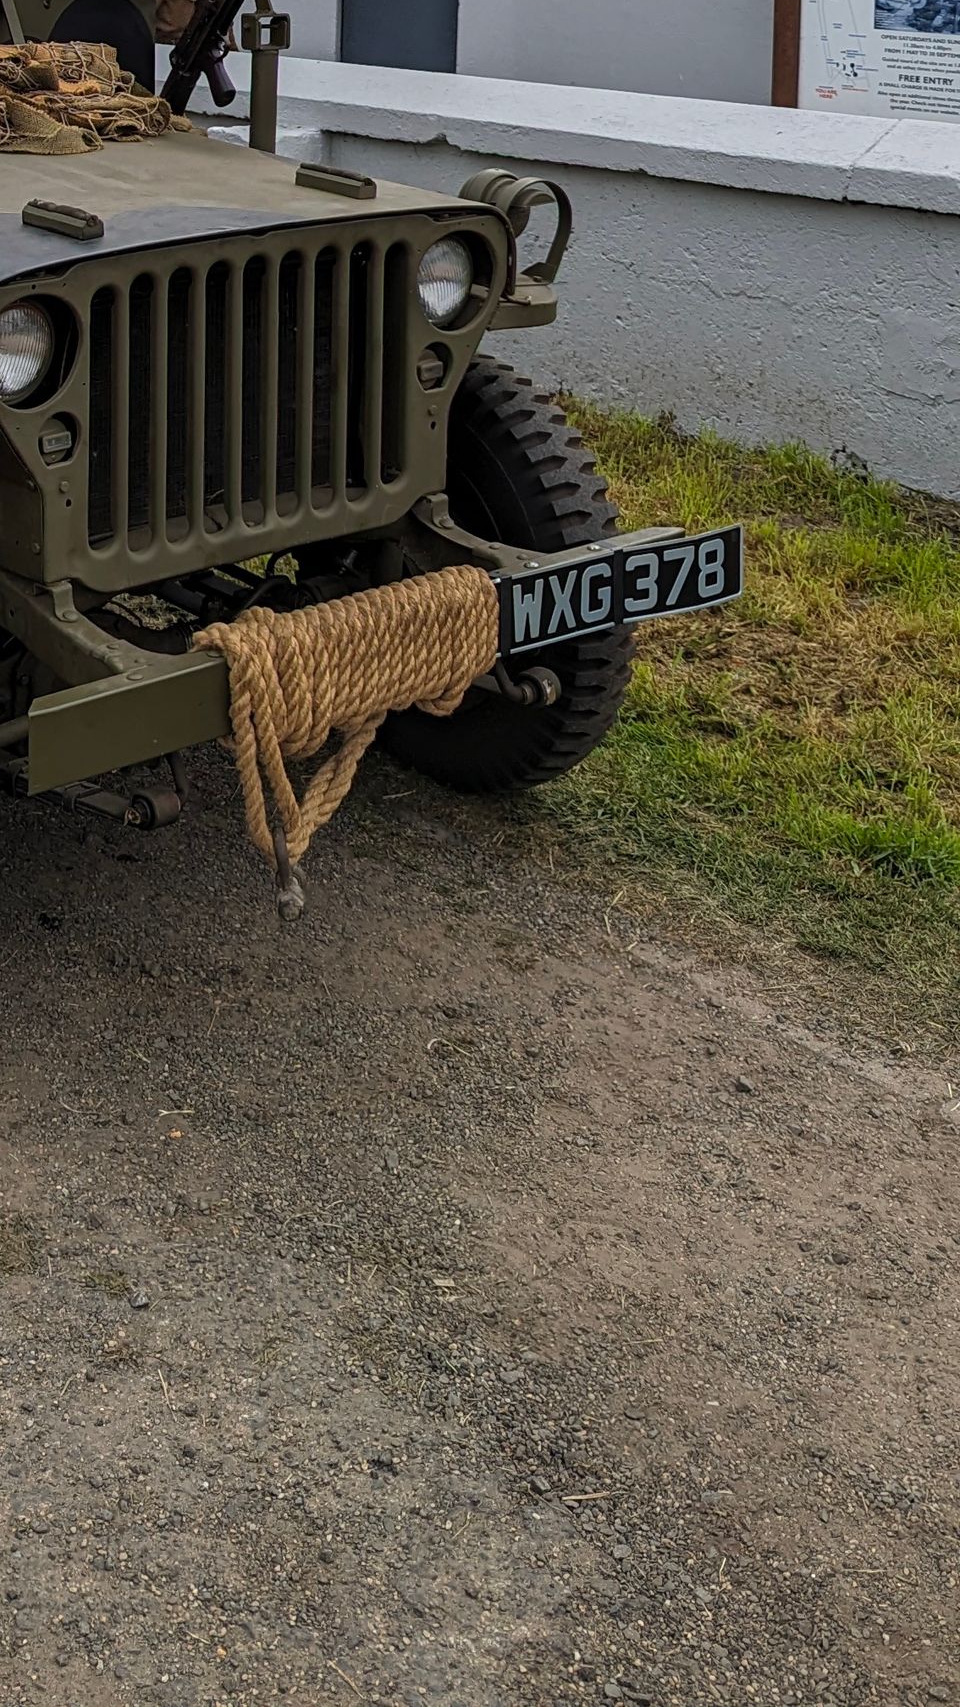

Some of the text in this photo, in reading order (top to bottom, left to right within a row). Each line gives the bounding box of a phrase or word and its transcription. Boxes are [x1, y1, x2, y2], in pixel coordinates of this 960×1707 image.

[898, 74, 954, 86] FREE ENTRY
[512, 538, 725, 643] WXG 378
